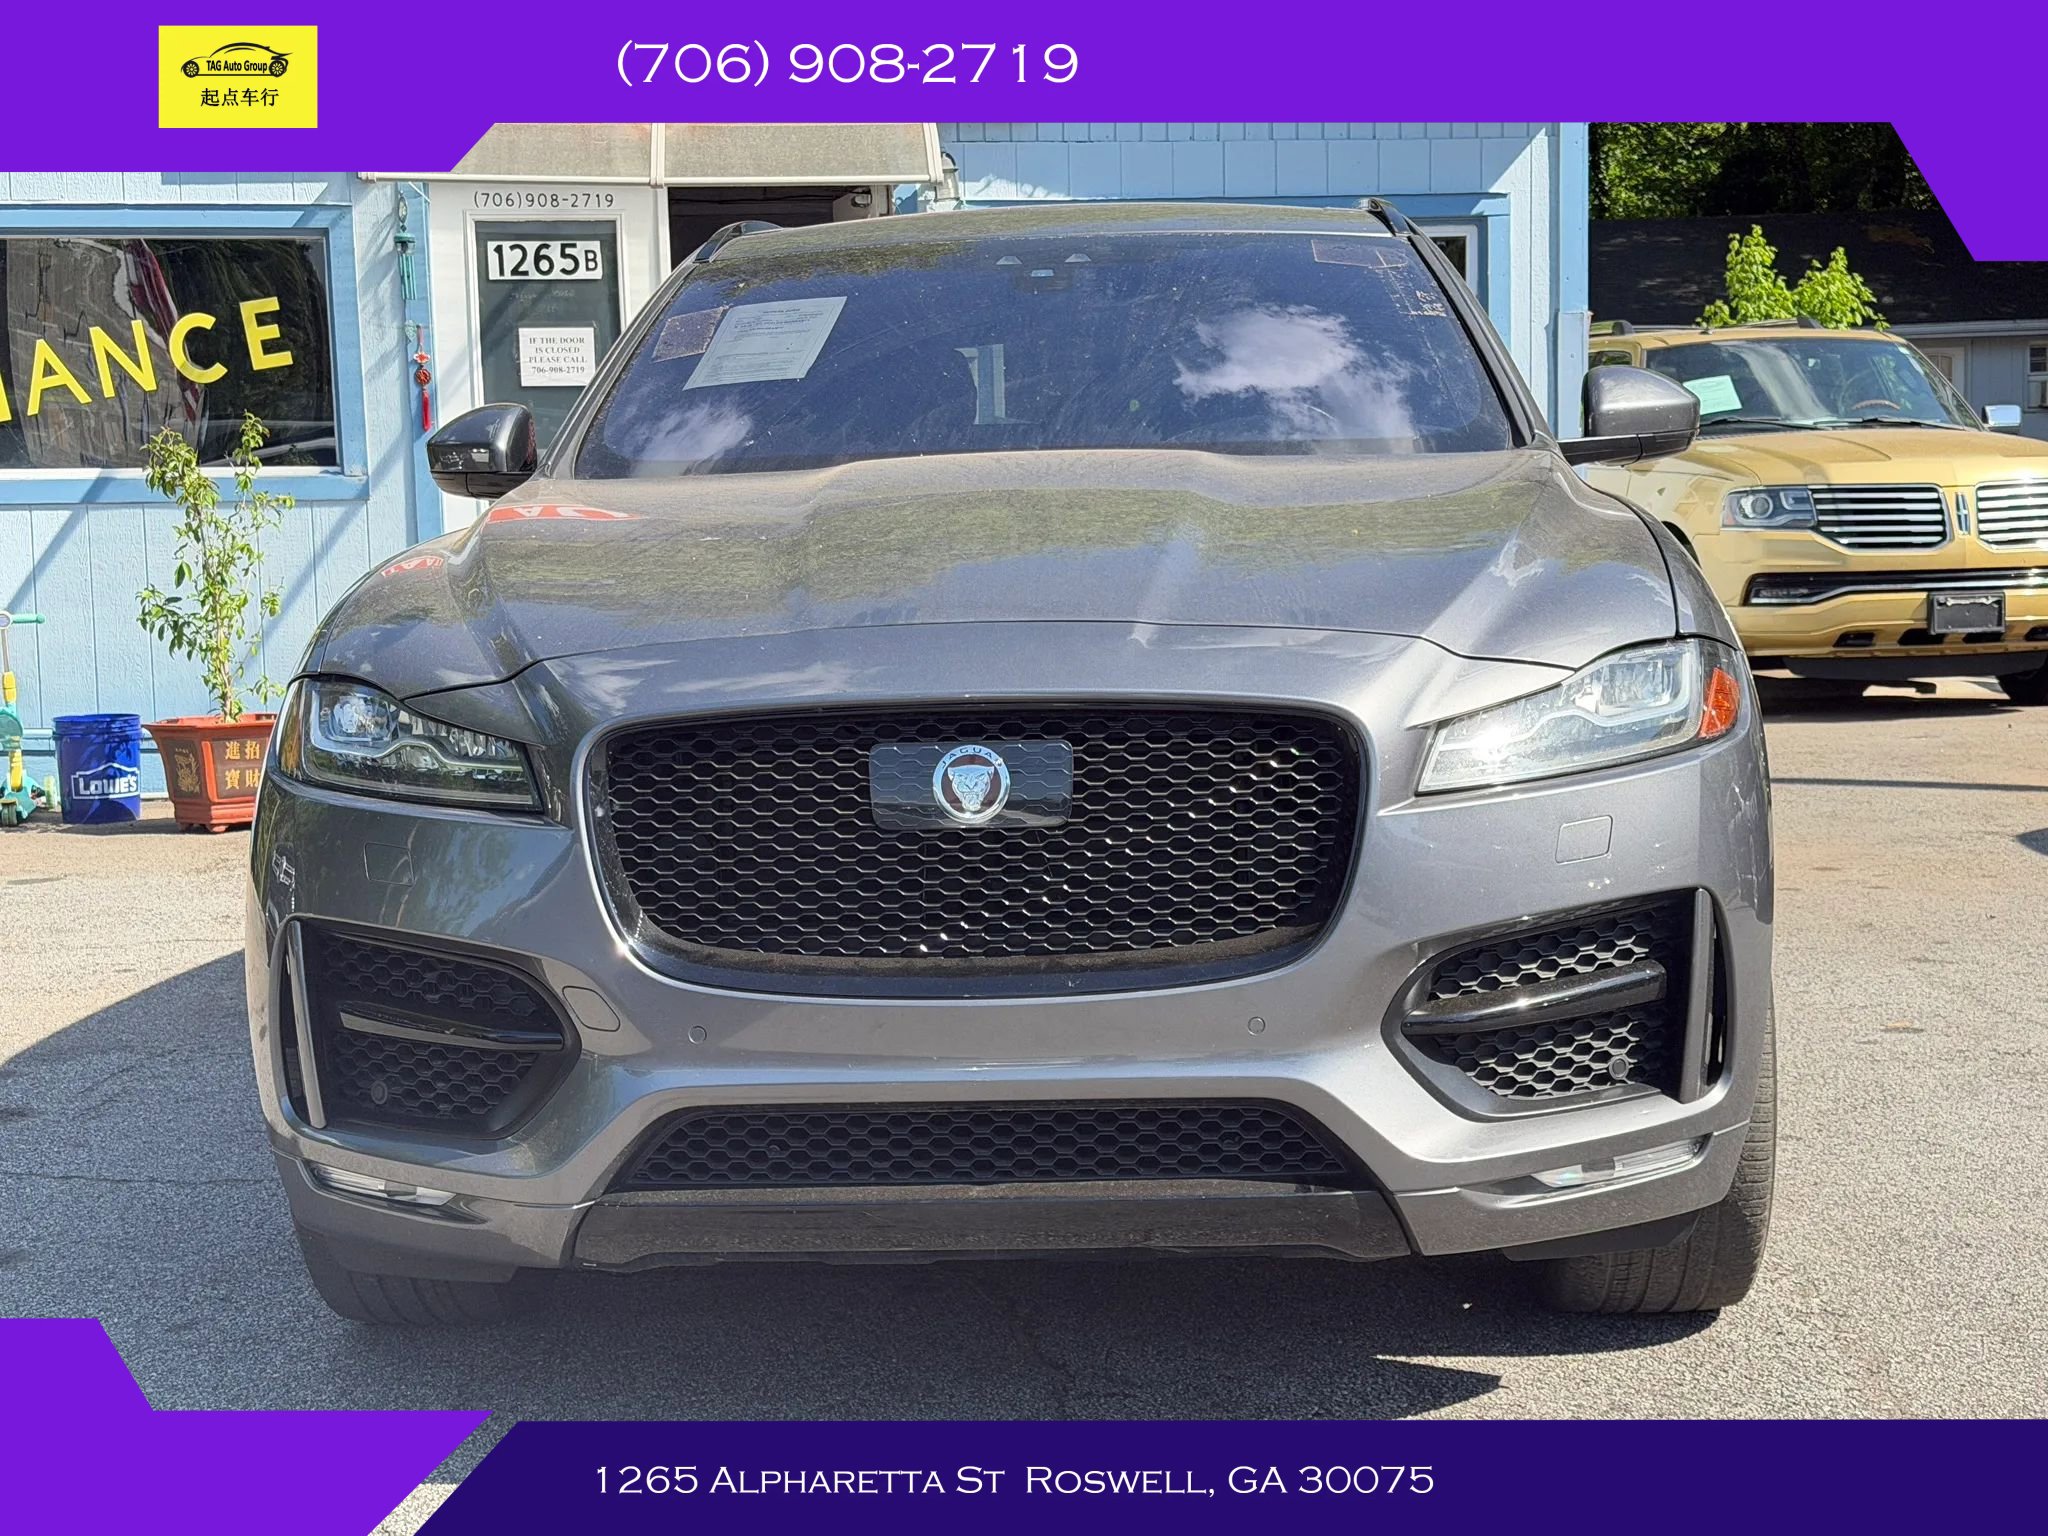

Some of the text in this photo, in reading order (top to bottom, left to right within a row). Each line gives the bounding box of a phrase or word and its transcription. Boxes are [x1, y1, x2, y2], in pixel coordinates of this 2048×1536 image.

[473, 191, 615, 209] (706)908-2719
[529, 337, 585, 345] IF THE DOOR
[0, 296, 294, 422] ANCE
[528, 356, 562, 364] PLEASE
[531, 366, 585, 374] 706-908-2719
